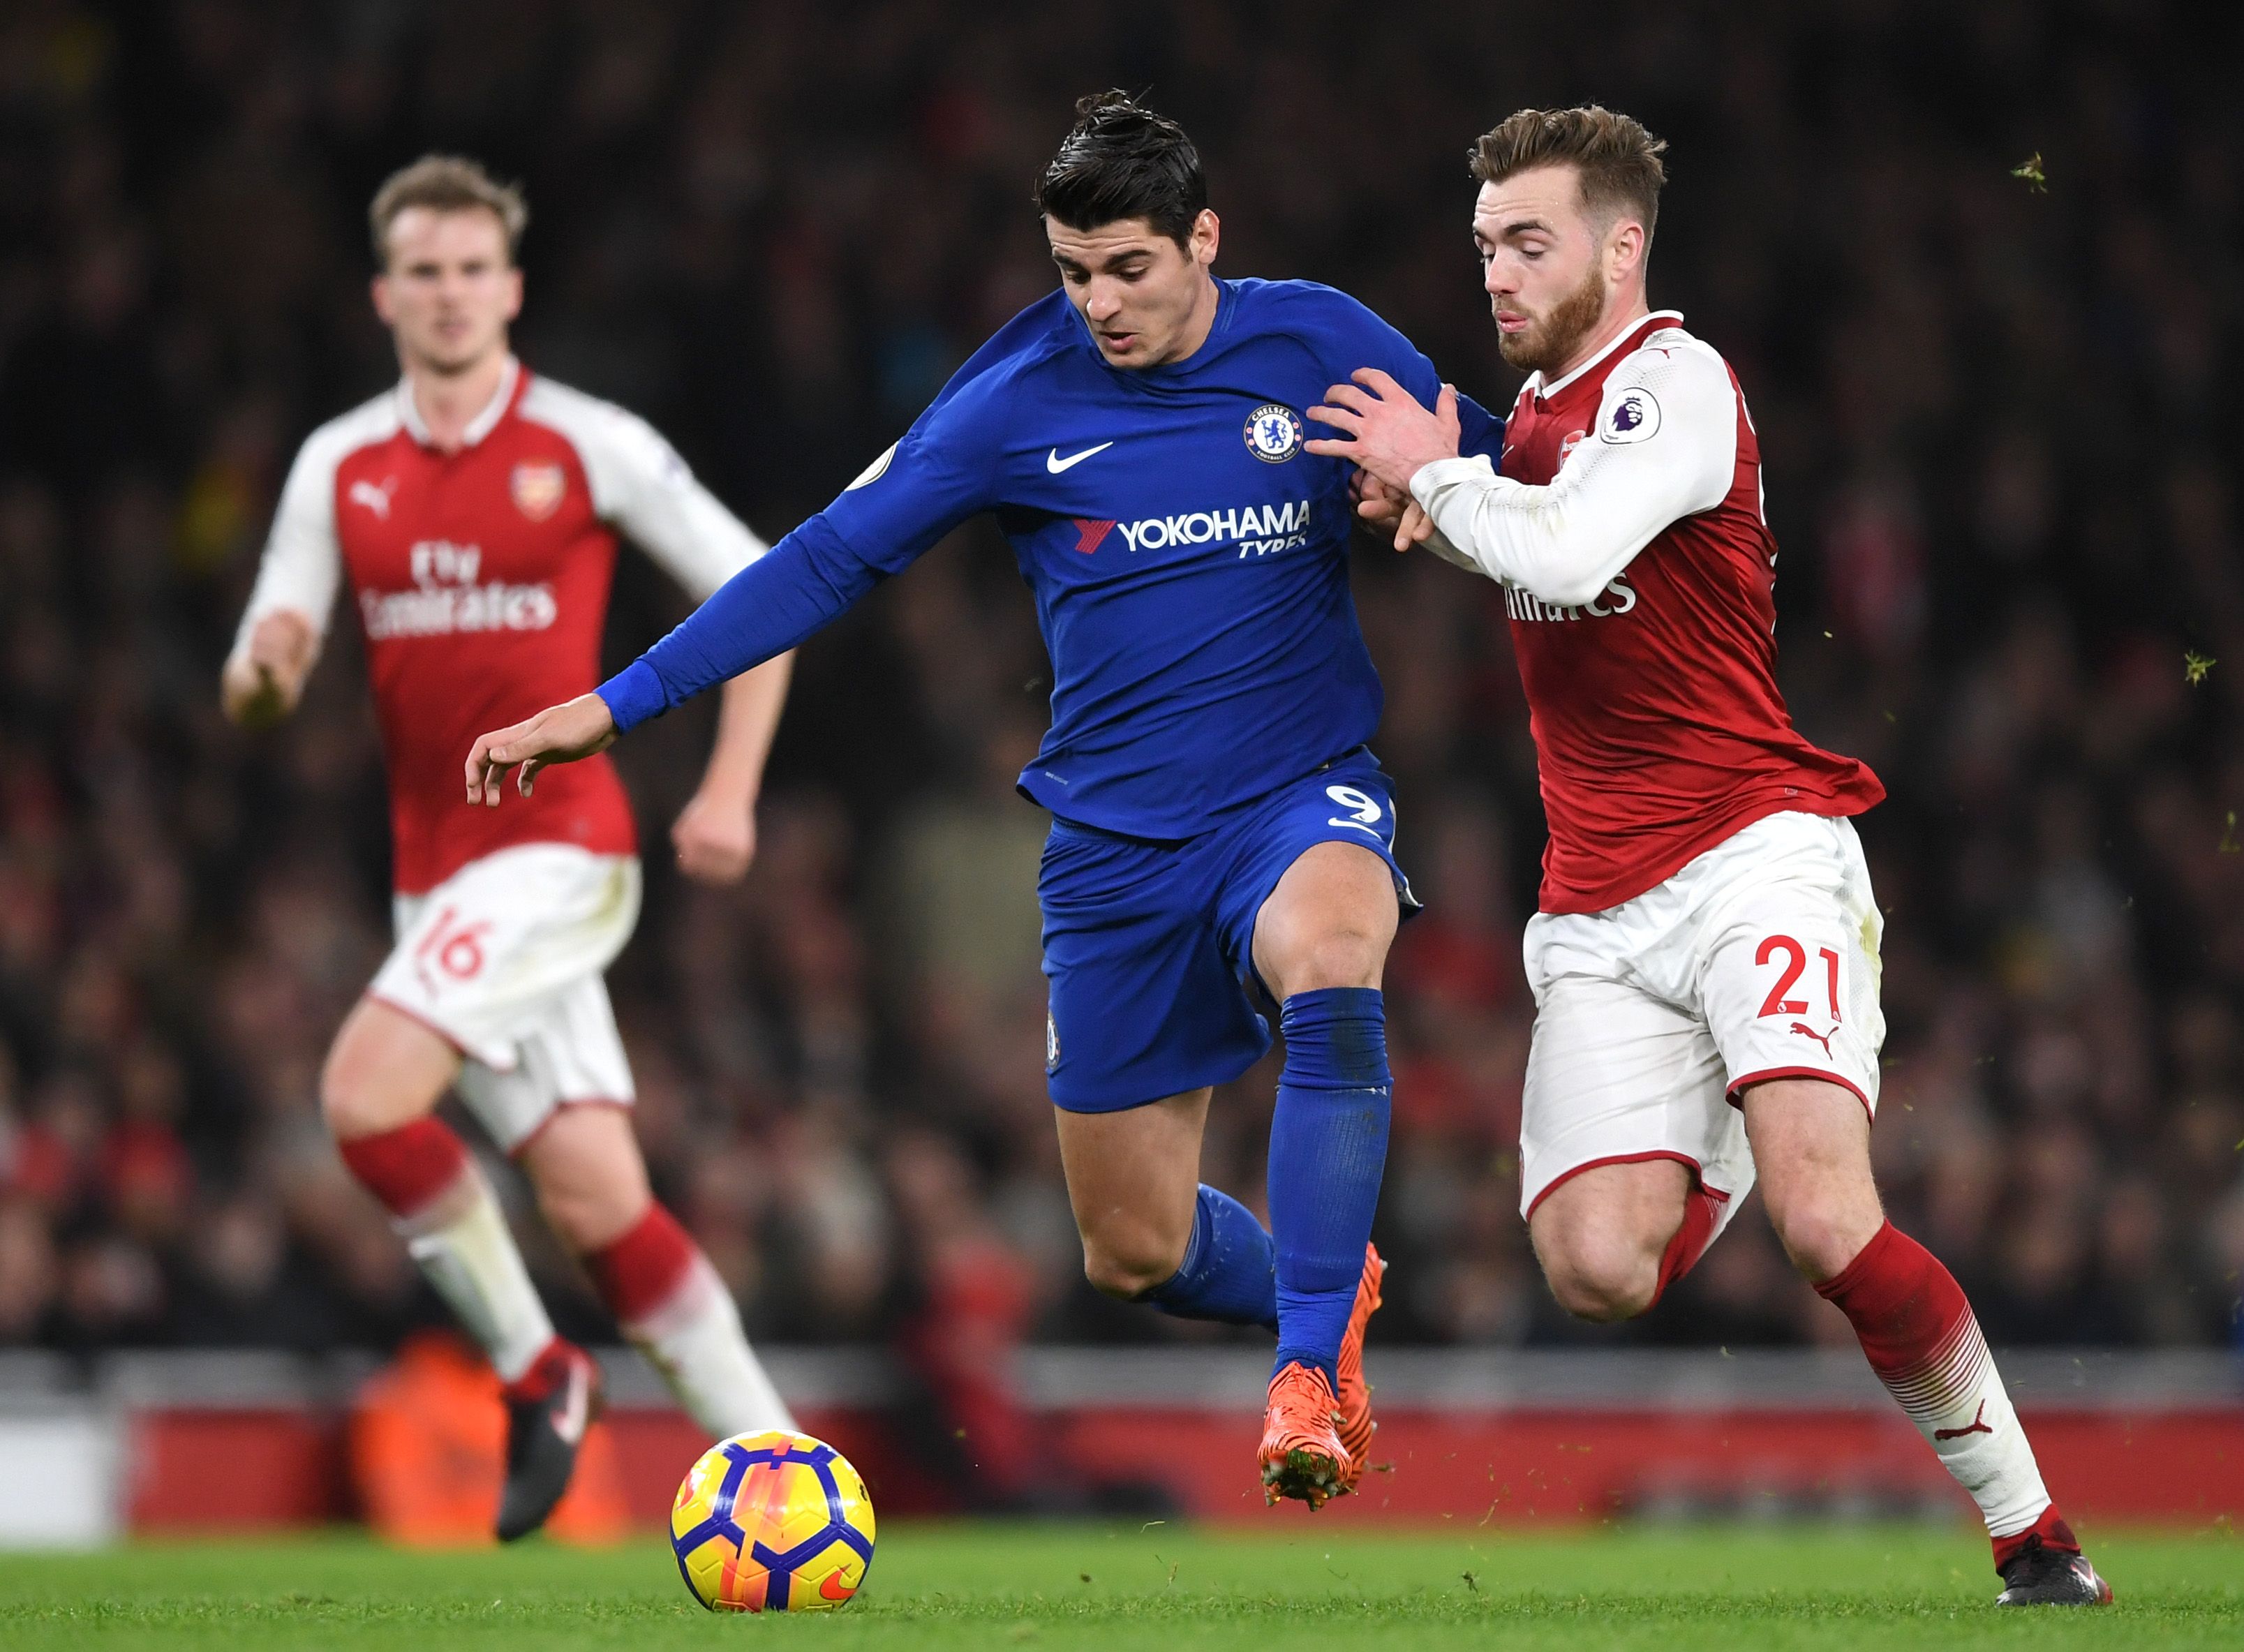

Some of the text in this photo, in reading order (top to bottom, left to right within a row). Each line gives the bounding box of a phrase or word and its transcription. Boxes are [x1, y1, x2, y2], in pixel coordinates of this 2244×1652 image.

[1251, 407, 1290, 422] CHELSEA
[1117, 500, 1310, 552] YOKOHAMA
[1326, 785, 1381, 823] 9
[416, 906, 494, 981] 16
[1755, 935, 1842, 1023] 21
